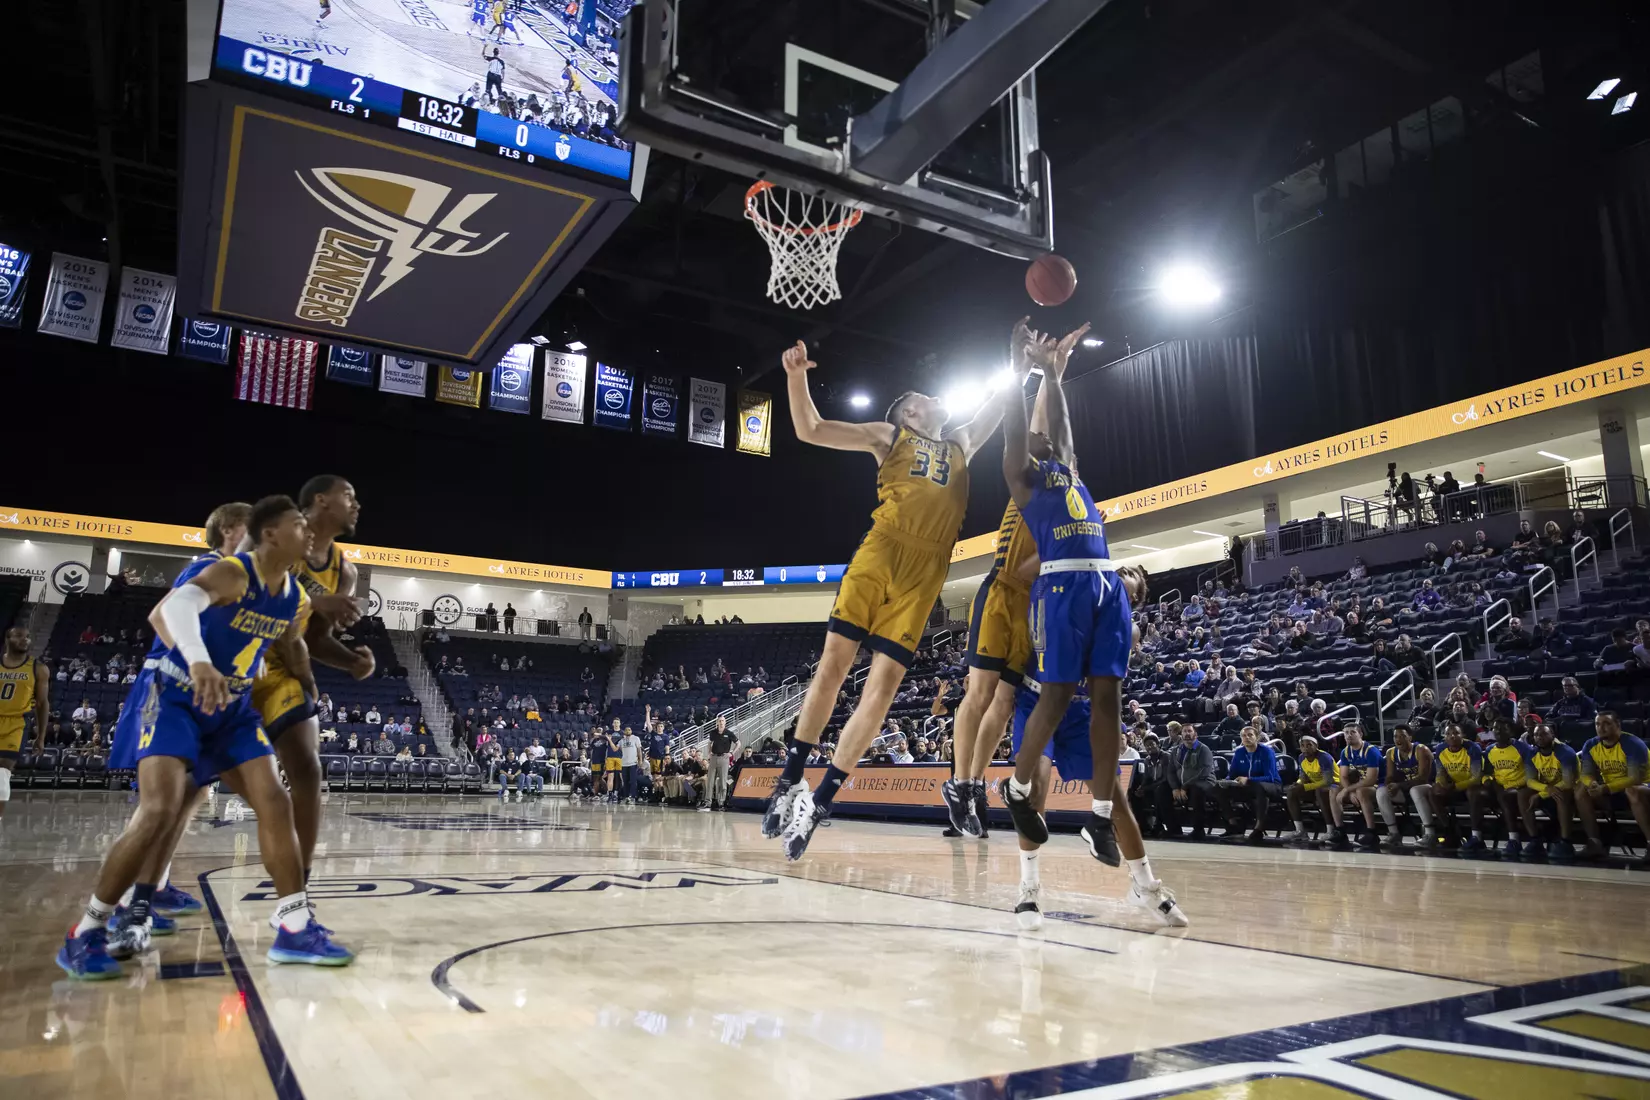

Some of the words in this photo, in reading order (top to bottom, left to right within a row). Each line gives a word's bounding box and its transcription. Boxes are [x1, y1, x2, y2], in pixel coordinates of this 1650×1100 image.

[262, 35, 350, 56] Altura
[242, 47, 313, 88] CBU
[349, 77, 365, 103] 2
[331, 99, 355, 114] FLS
[363, 109, 371, 118] 1
[418, 96, 464, 128] 18:32
[412, 122, 434, 134] 1ST
[439, 129, 467, 143] HALF
[515, 124, 529, 147] 0
[498, 146, 521, 159] FLS
[527, 154, 535, 163] 0
[0, 247, 20, 260] 16
[63, 261, 96, 275] 2015
[64, 273, 91, 283] MEN'S
[133, 276, 163, 288] 2014
[296, 227, 384, 328] LANCERS
[51, 278, 103, 292] BASKETBALL
[134, 287, 159, 296] MEN'S
[121, 292, 170, 306] BASKETBALL
[48, 310, 87, 322] DIVISION
[48, 318, 79, 328] SWEET
[116, 329, 168, 342] TOURNAMENT
[124, 324, 156, 334] DIVISION
[180, 336, 227, 350] CHAMPIONS
[330, 360, 372, 373] CHAMPIONS
[554, 357, 576, 367] 2016
[401, 372, 424, 380] REGION
[547, 372, 583, 382] BASKETBALL
[604, 365, 627, 376] 2017
[385, 376, 421, 386] CHAMPIONS
[597, 379, 633, 391] BASKETBALL
[600, 374, 628, 383] WOMEN'S
[651, 375, 674, 386] 2017
[645, 388, 679, 400] BASKETBALL
[648, 384, 675, 392] WOMEN'S
[697, 385, 718, 394] 2017
[1482, 388, 1545, 418] AYRES
[1554, 361, 1645, 398] HOTELS
[490, 391, 528, 402] CHAMPIONS
[596, 409, 631, 419] CHAMPIONS
[645, 423, 675, 433] CHAMPIONS
[1275, 449, 1321, 472] AYRES
[1326, 430, 1388, 459] HOTELS
[909, 450, 950, 487] 33
[1122, 494, 1157, 512] AYRES
[1161, 480, 1208, 502] HOTELS
[1066, 486, 1089, 521] 0
[22, 516, 70, 529] AYRES
[76, 521, 134, 535] HOTELS
[1053, 521, 1104, 540] UNIVERSITY
[363, 552, 401, 563] AYRES
[405, 555, 450, 568] HOTELS
[506, 566, 540, 577] AYRES
[543, 570, 584, 581] HOTELS
[651, 573, 680, 587] CBU
[699, 571, 707, 585] 2
[732, 569, 754, 581] 18:32
[780, 568, 787, 582] 0
[386, 600, 420, 608] EQUIPPED
[229, 607, 290, 640] WESTCLIFF
[855, 777, 887, 791] AYRES
[890, 778, 936, 792] HOTELS
